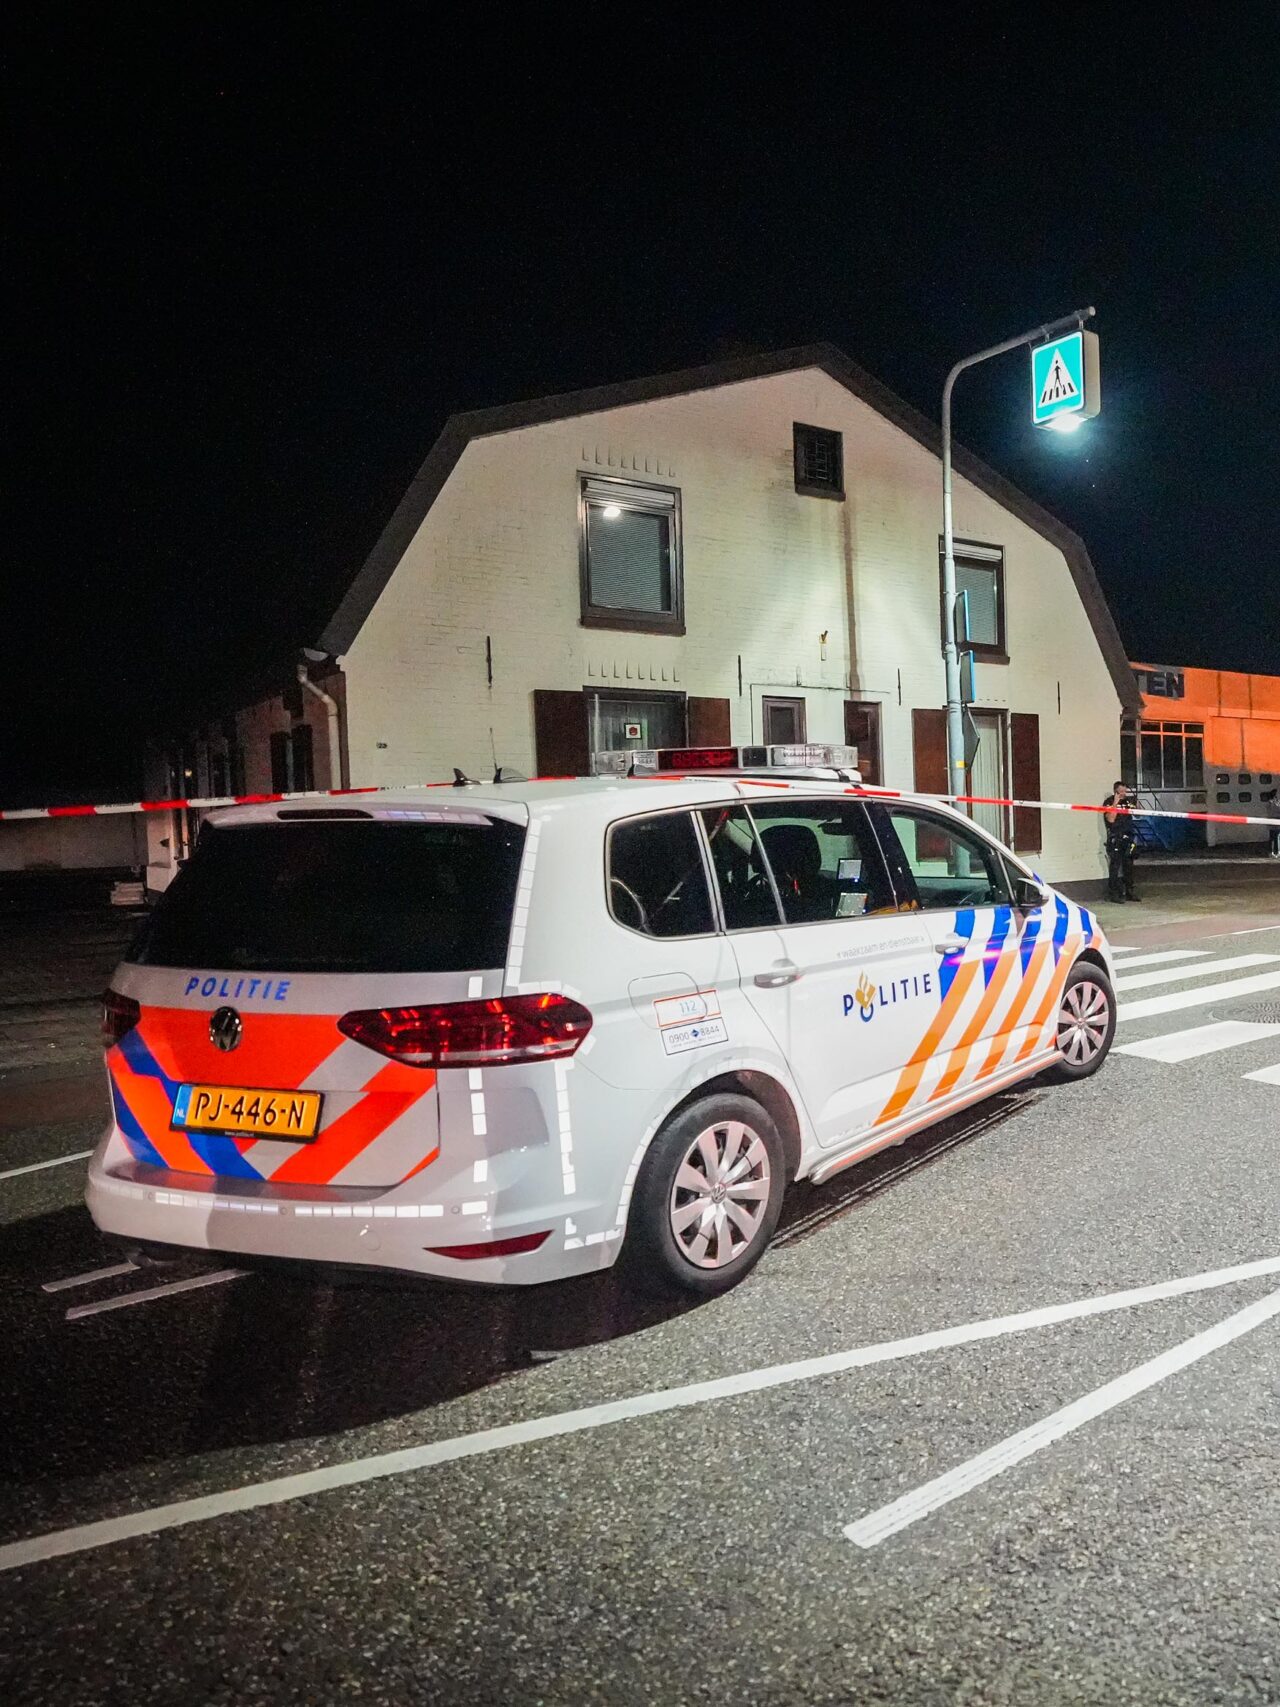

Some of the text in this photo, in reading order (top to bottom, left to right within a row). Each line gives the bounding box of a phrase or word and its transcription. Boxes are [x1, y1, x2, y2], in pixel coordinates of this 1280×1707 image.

[184, 976, 290, 1001] POLITIE
[843, 973, 932, 1022] POLITIE
[680, 1000, 697, 1014] 112
[668, 1031, 690, 1044] 0900
[700, 1025, 720, 1037] 8844
[194, 1092, 306, 1129] PJ-446-N
